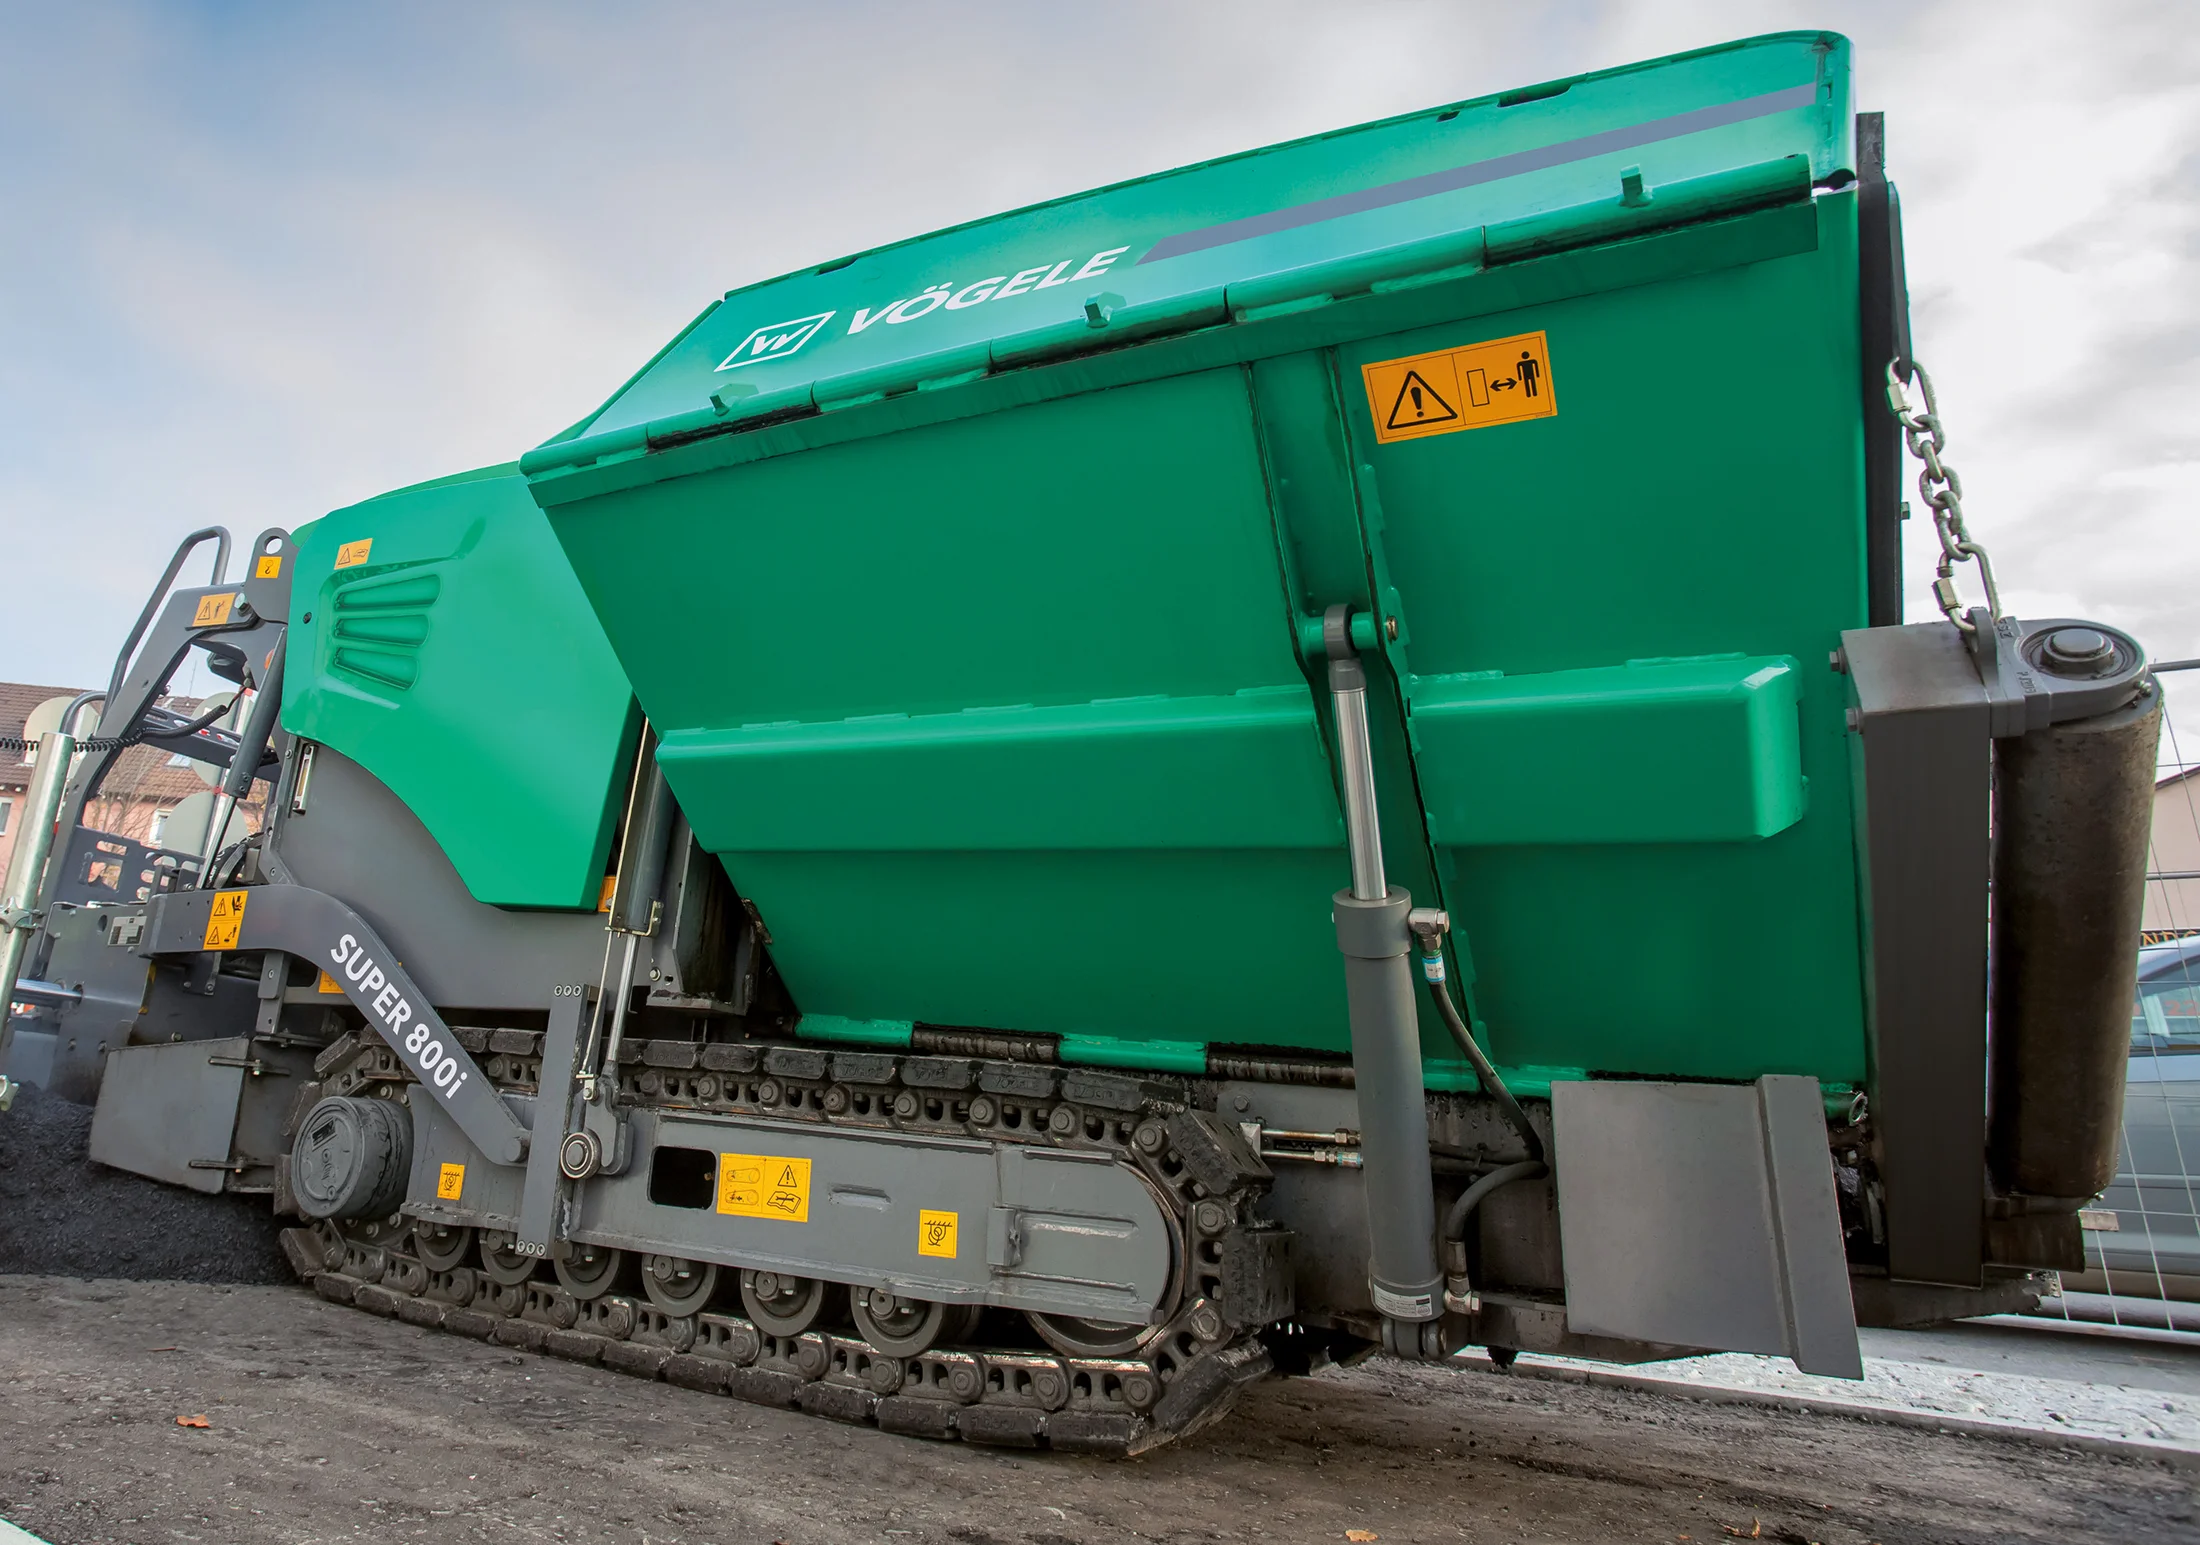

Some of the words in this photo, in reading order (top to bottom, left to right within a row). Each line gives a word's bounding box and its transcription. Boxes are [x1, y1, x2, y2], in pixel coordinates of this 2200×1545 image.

[846, 245, 1131, 335] VÖGELE
[330, 933, 412, 1036] SUPER
[405, 1023, 468, 1100] 800i
